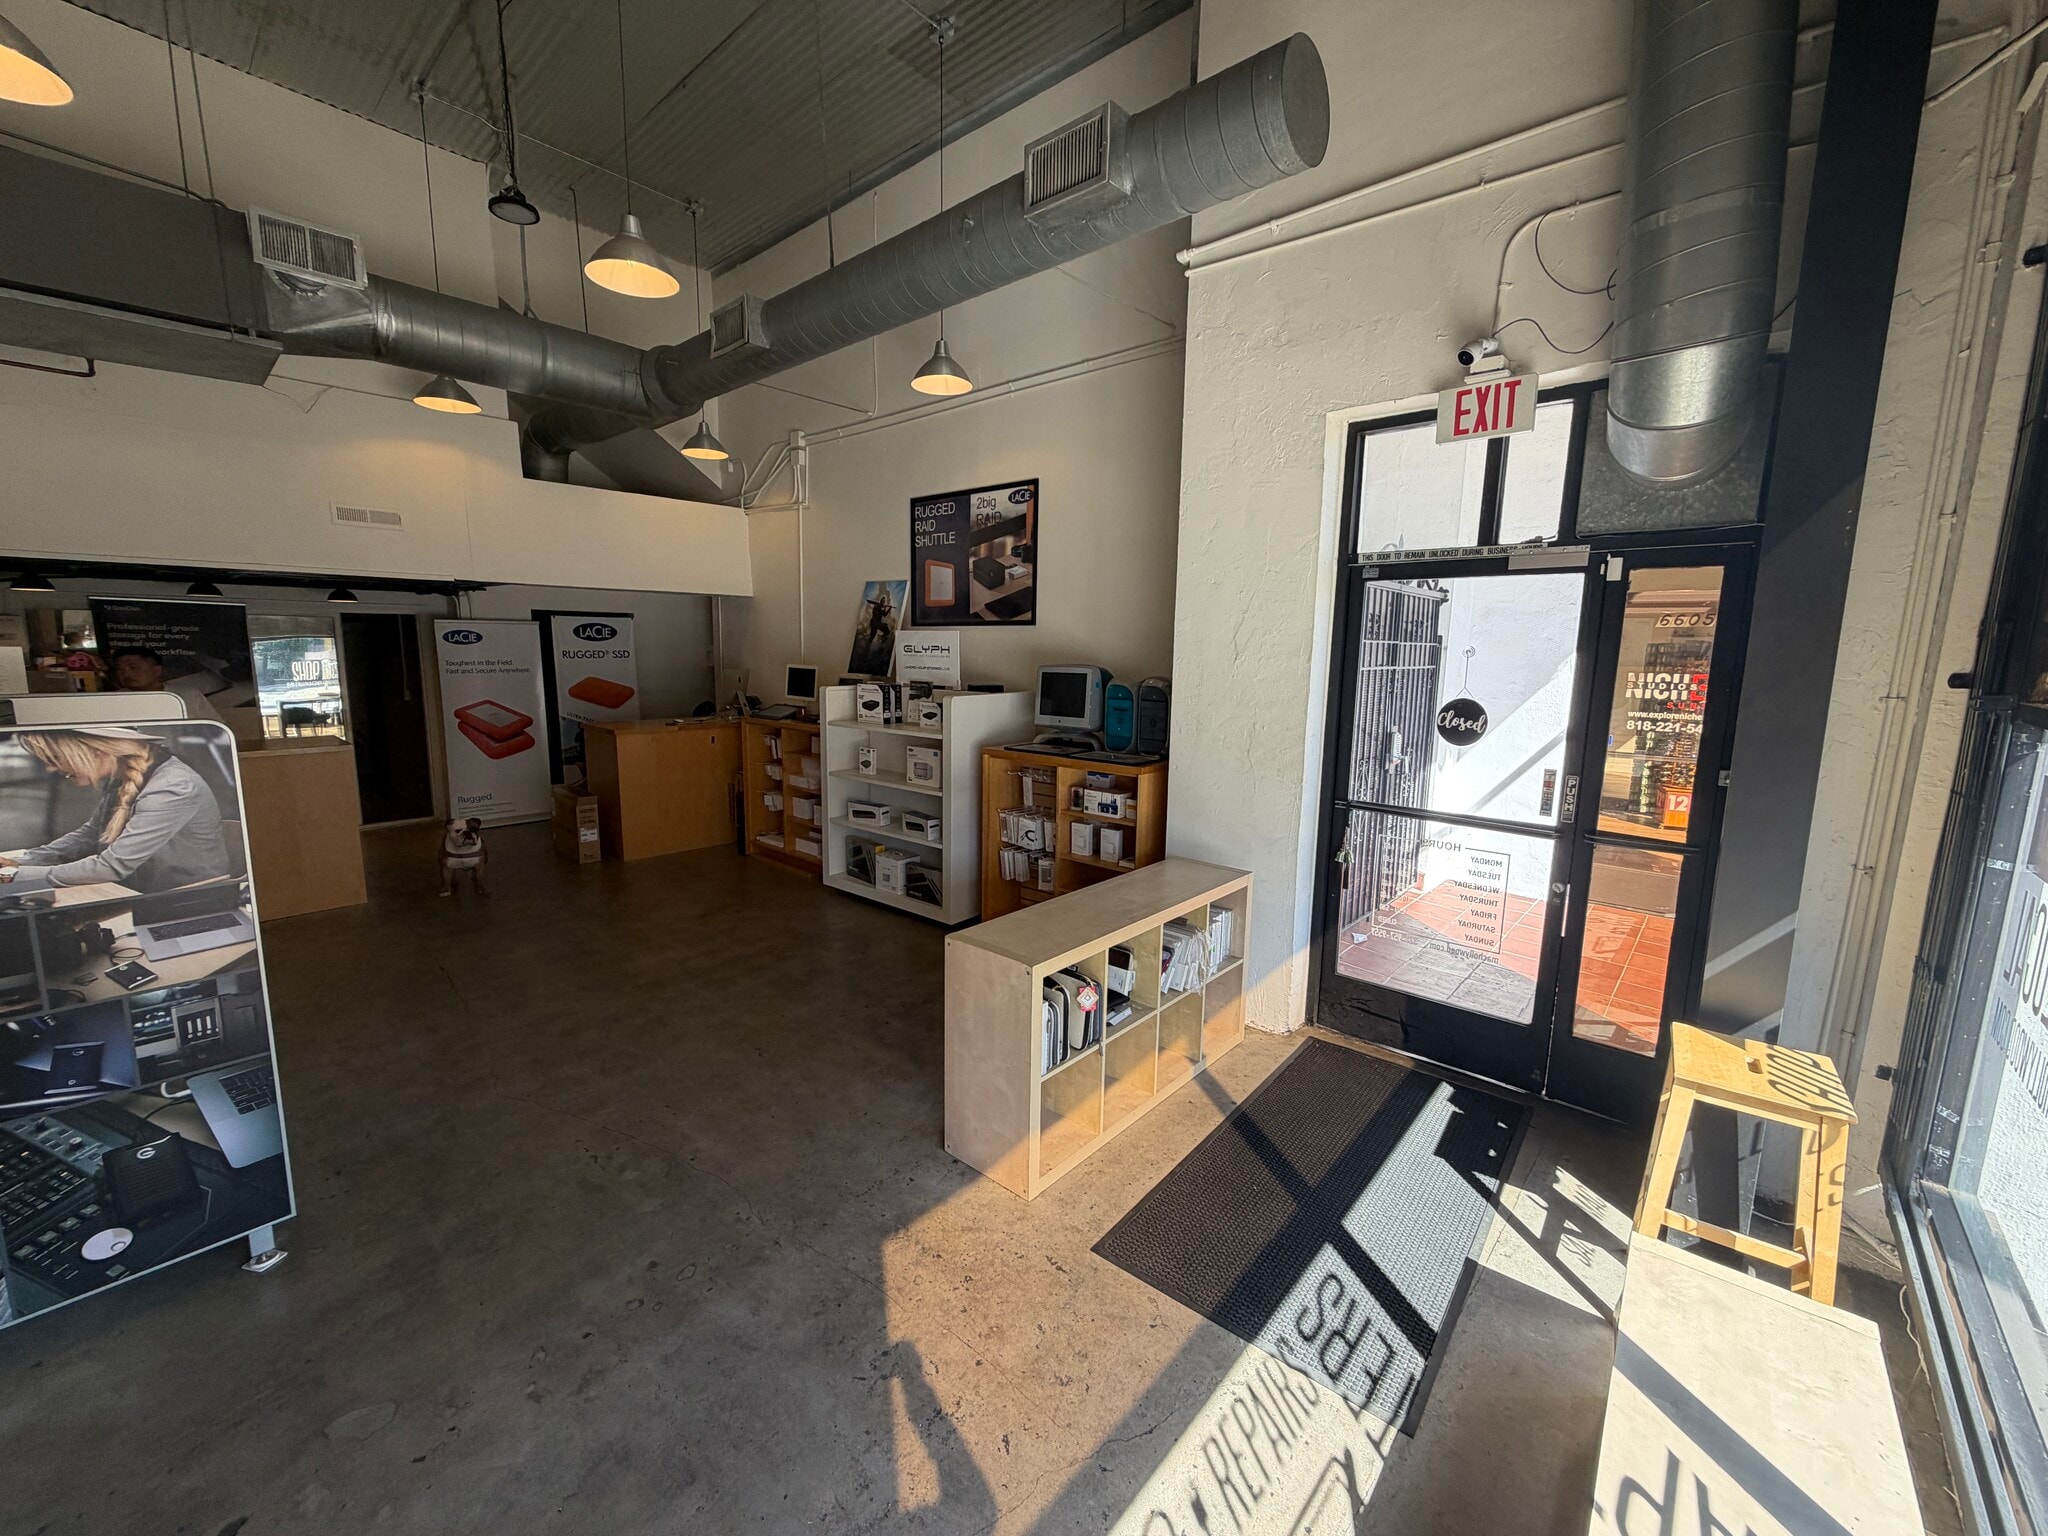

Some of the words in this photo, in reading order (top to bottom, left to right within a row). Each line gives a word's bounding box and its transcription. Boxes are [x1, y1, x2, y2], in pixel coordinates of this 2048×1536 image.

[1453, 379, 1522, 437] EXIT
[914, 501, 956, 519] RUGGED
[976, 496, 997, 511] 2big
[914, 519, 936, 533] RAID
[976, 511, 1002, 527] RAID
[914, 531, 956, 548] SHUTTLE
[1362, 553, 1374, 562] THIS
[1376, 552, 1391, 561] DOOR
[1394, 552, 1402, 560] TO
[1404, 551, 1426, 560] REMAIN
[1428, 549, 1459, 558] UNLOCKED
[1461, 547, 1484, 556] DURING
[1659, 612, 1717, 628] 6605
[612, 650, 631, 659] SSD
[903, 644, 950, 654] GLYPH
[291, 660, 320, 681] SHOP
[445, 659, 476, 667] Toughest
[446, 667, 459, 675] Fast
[1626, 681, 1698, 690] STUDIOS
[1437, 709, 1486, 734] Closed
[457, 792, 493, 804] Rugged
[1564, 779, 1577, 812] PUSH
[1668, 794, 1689, 812] 12
